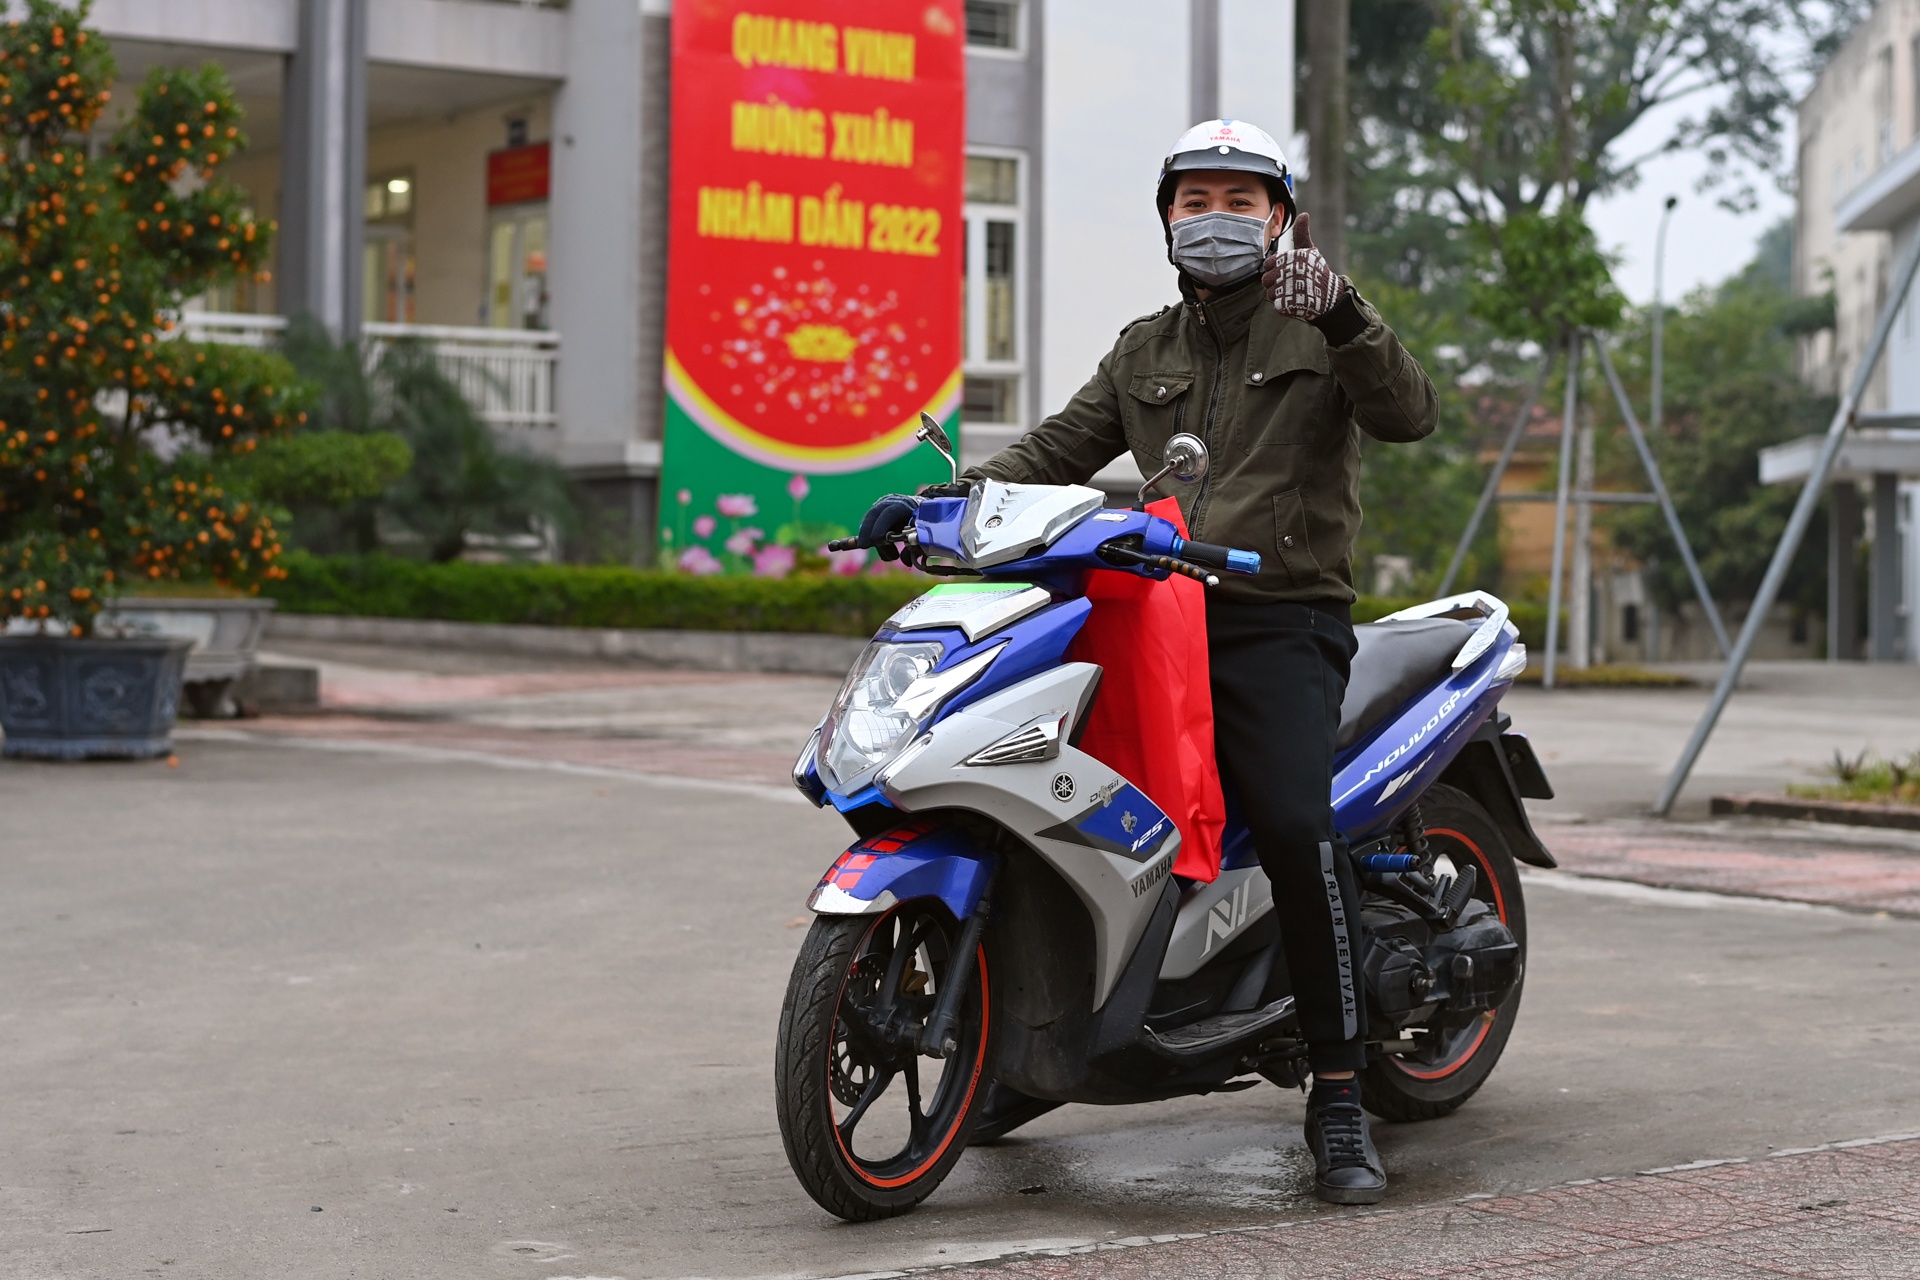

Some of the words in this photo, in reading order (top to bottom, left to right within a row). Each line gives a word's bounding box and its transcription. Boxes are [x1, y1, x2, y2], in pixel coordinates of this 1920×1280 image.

[732, 12, 838, 72] QUANG
[843, 26, 915, 82] VINH
[831, 107, 913, 168] XUÂN
[1209, 135, 1241, 143] YAMAHA
[698, 181, 793, 243] NHÂM
[868, 203, 941, 257] 2022
[1438, 690, 1461, 720] GP
[1130, 822, 1163, 853] 125
[1130, 855, 1173, 899] YAMAHA
[1323, 867, 1345, 926] TRAIN
[1336, 935, 1355, 1016] REVIVAL
